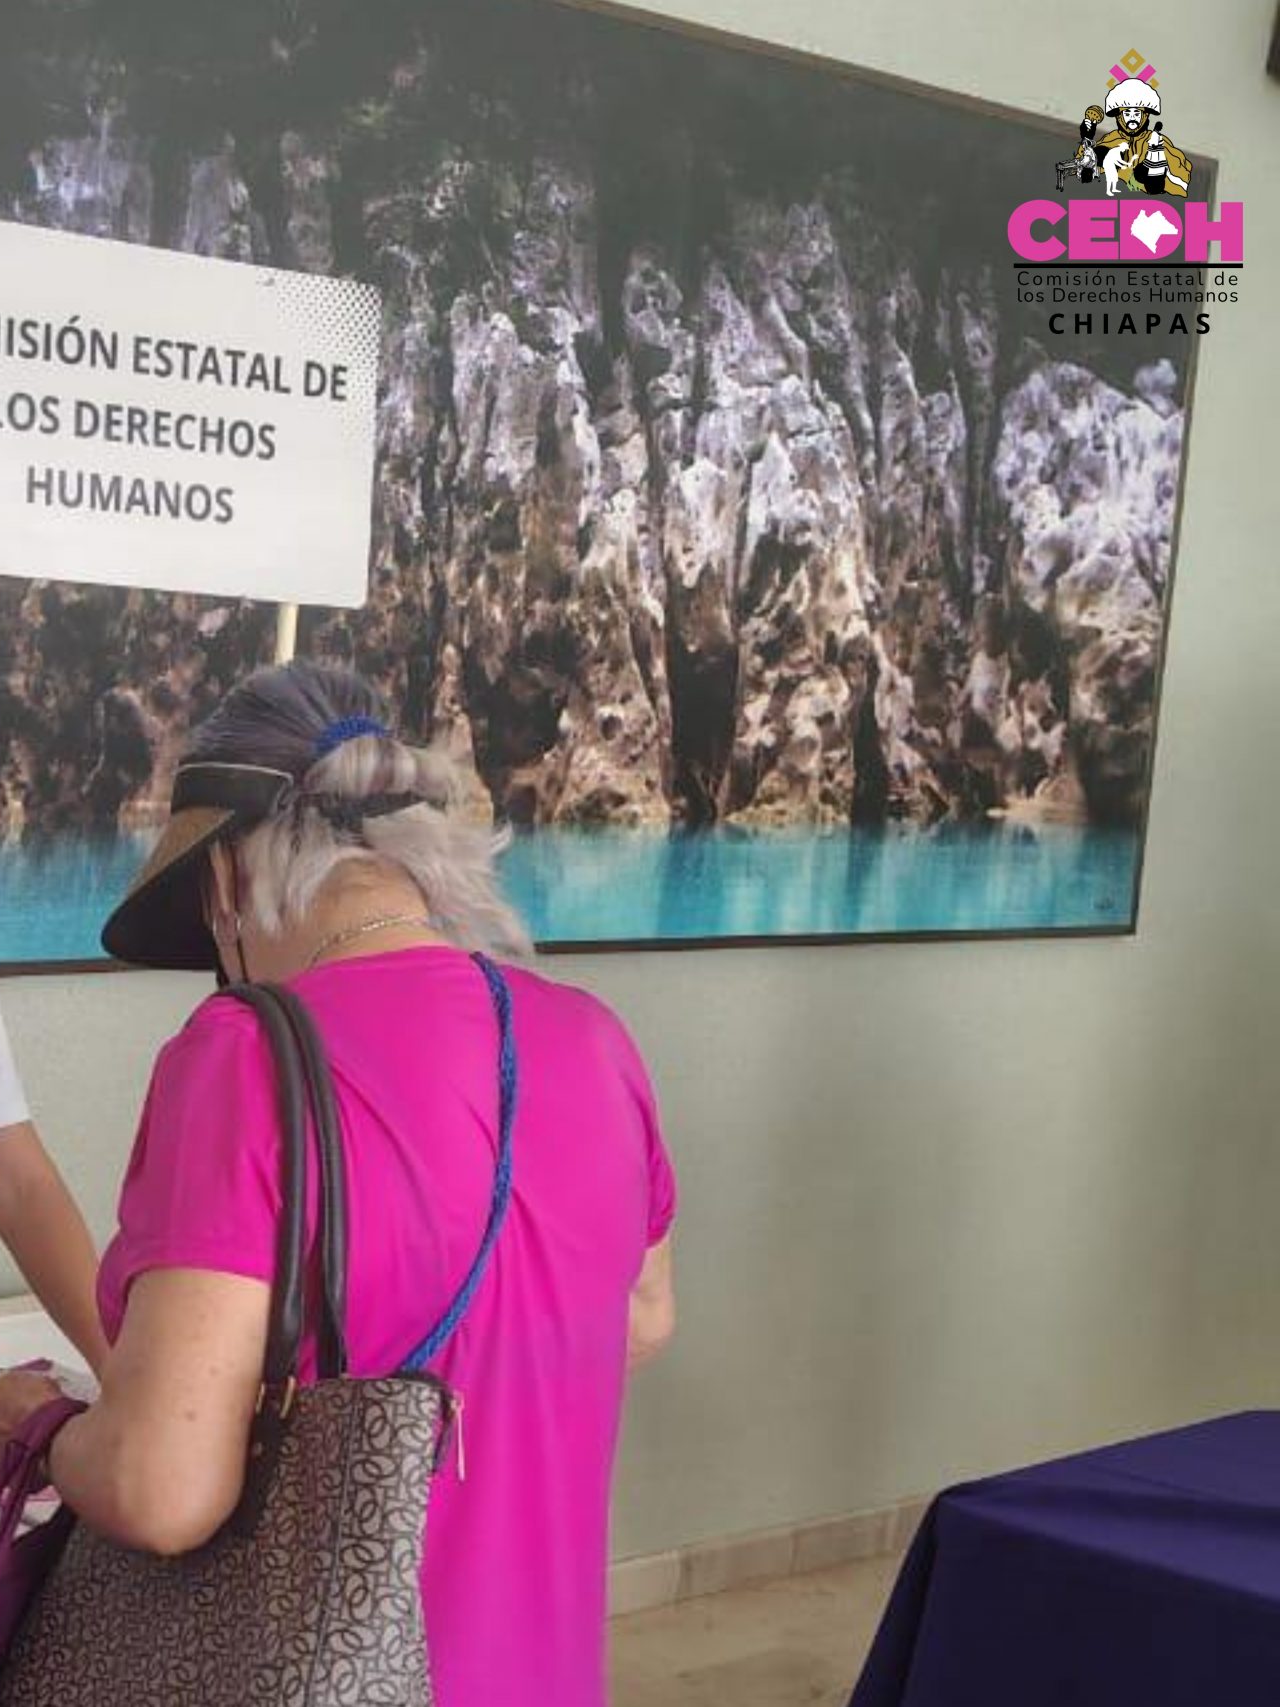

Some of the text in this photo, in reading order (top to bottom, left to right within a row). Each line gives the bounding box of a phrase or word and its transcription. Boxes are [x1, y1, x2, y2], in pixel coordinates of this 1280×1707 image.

[131, 336, 292, 396] ESTATAL
[303, 359, 348, 402] DE
[73, 392, 277, 461] DERECHOS
[26, 465, 234, 525] HUMANOS
